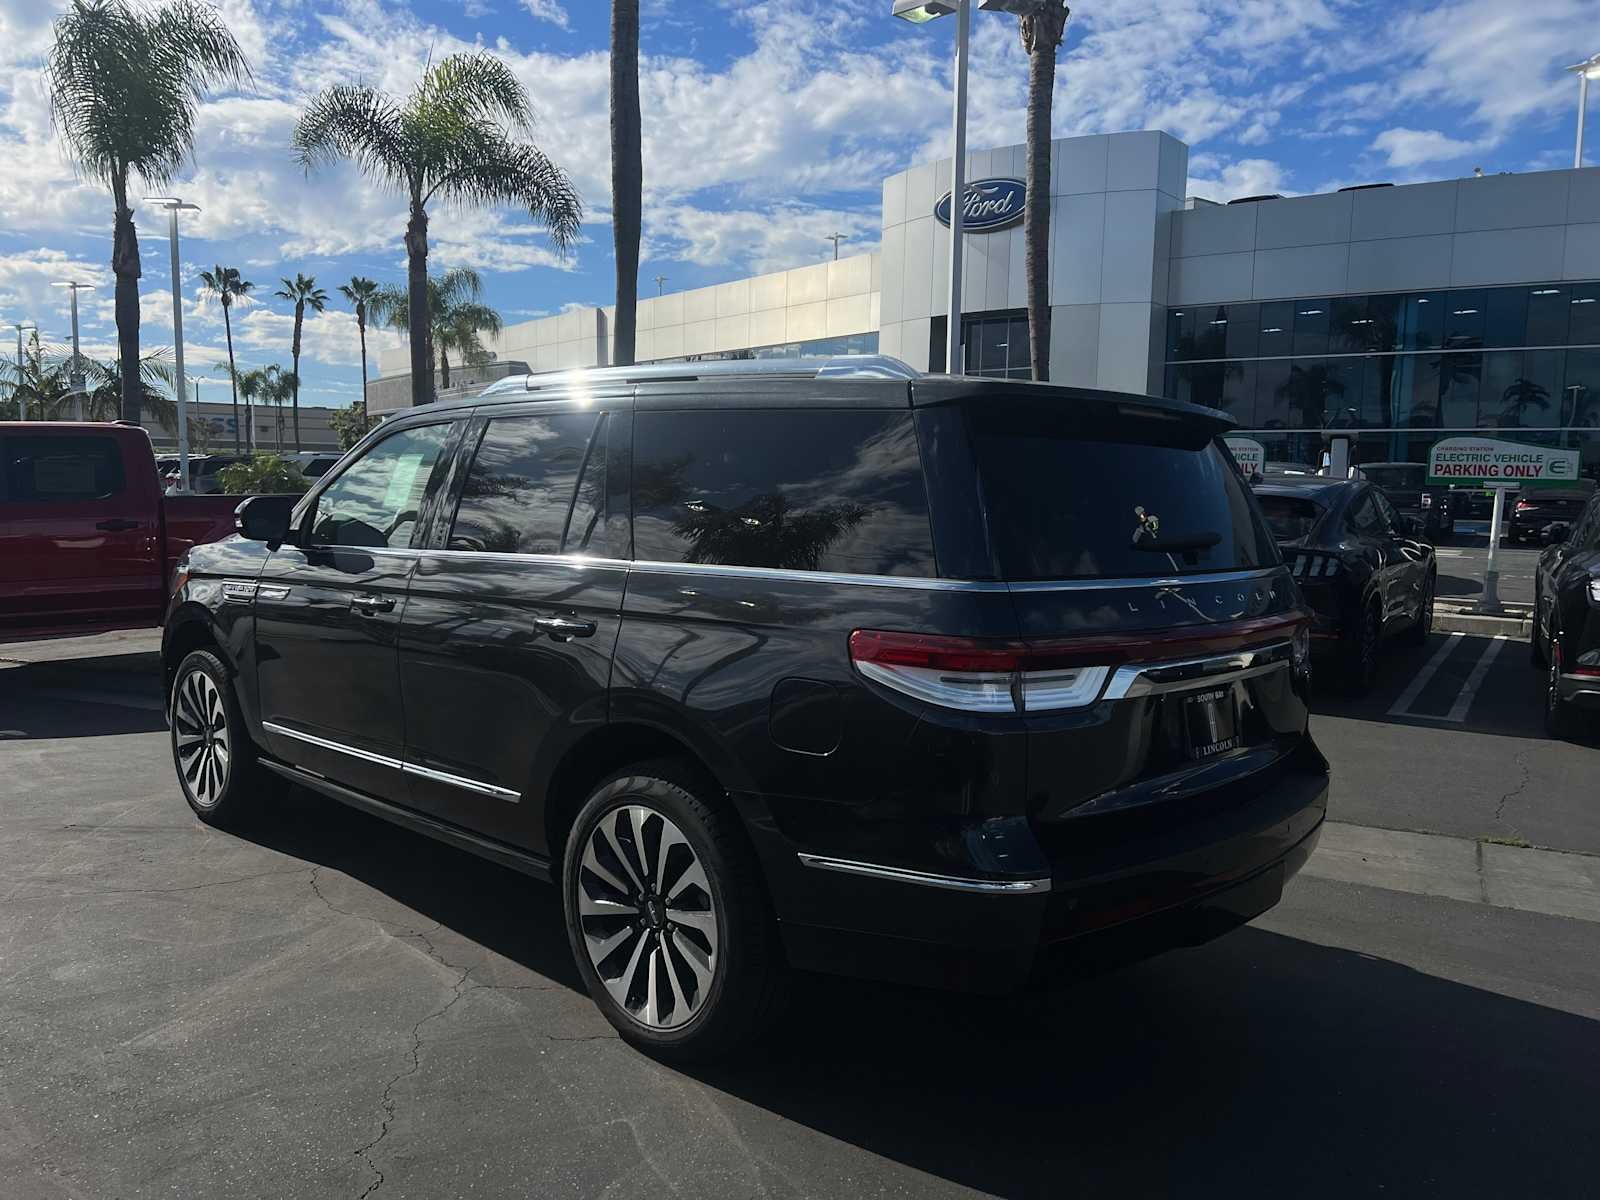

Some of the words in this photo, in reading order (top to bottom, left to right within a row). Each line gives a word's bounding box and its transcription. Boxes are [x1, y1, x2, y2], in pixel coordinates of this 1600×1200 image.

[963, 187, 1014, 217] Ford
[1436, 453, 1490, 462] ELECTRIC
[1494, 454, 1544, 463] VEHICLE
[1434, 464, 1498, 477] PARKING
[1503, 465, 1544, 477] ONLY
[1128, 591, 1276, 611] LINCOLN
[1202, 738, 1233, 755] LINCOLN
